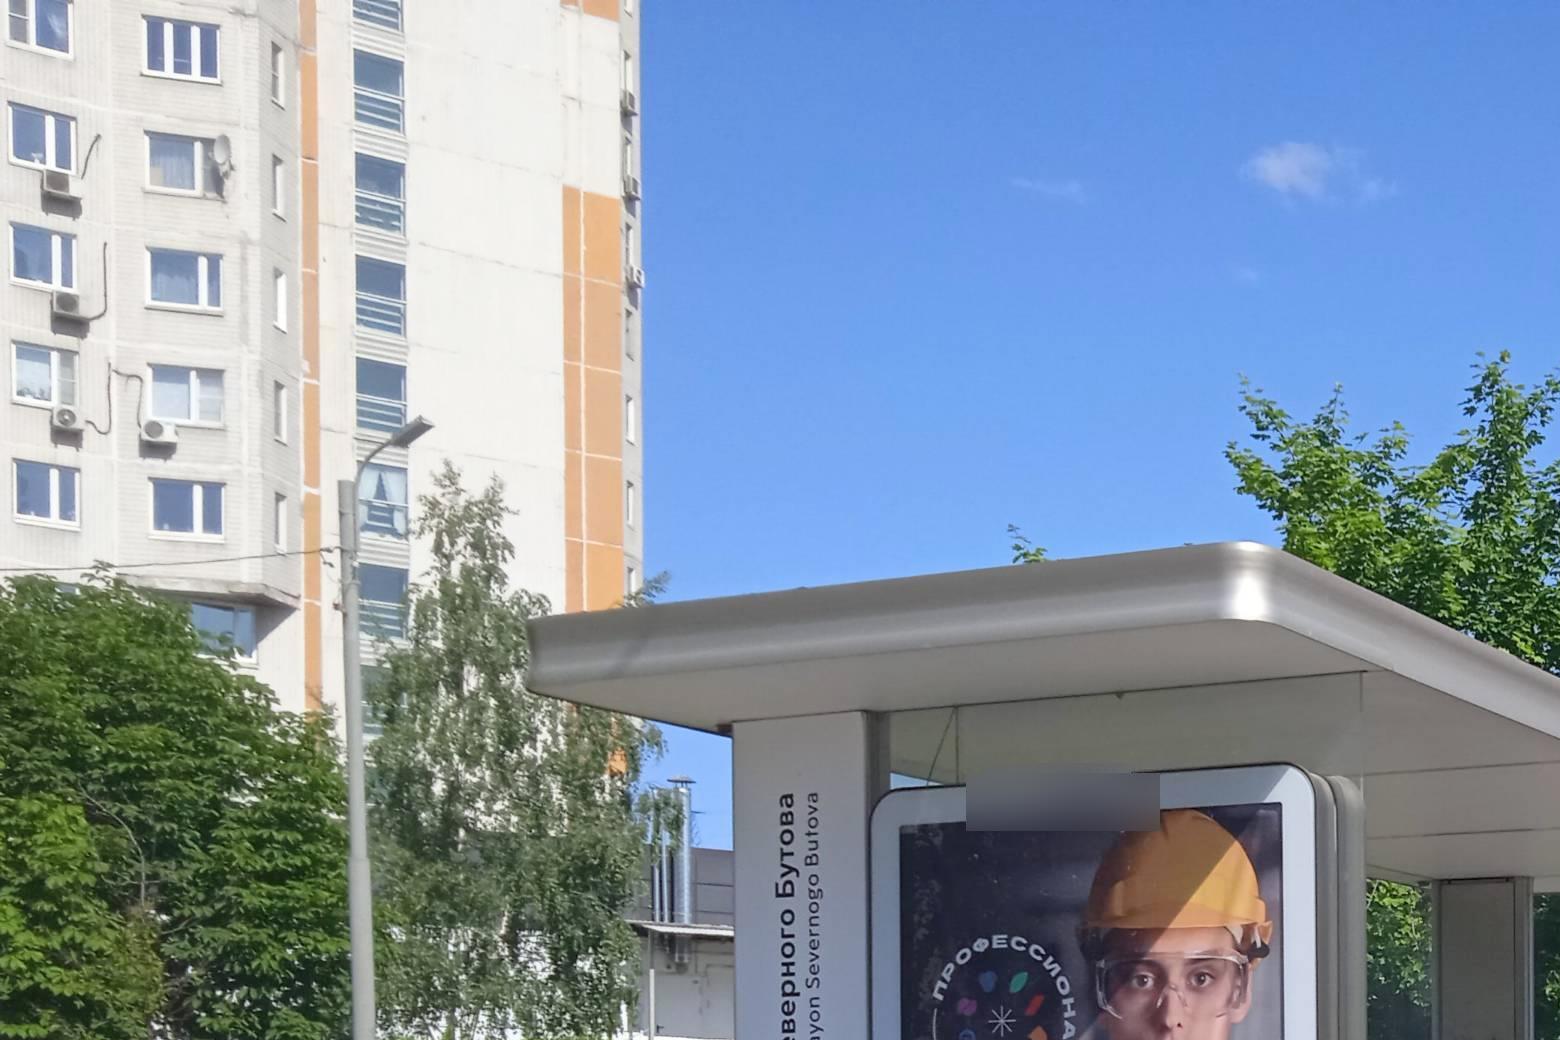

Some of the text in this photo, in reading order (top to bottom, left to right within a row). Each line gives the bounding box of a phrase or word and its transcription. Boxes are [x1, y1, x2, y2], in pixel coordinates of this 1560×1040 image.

[775, 793, 800, 898] Бутова
[804, 792, 819, 867] Butova
[805, 873, 824, 989] Severnogo
